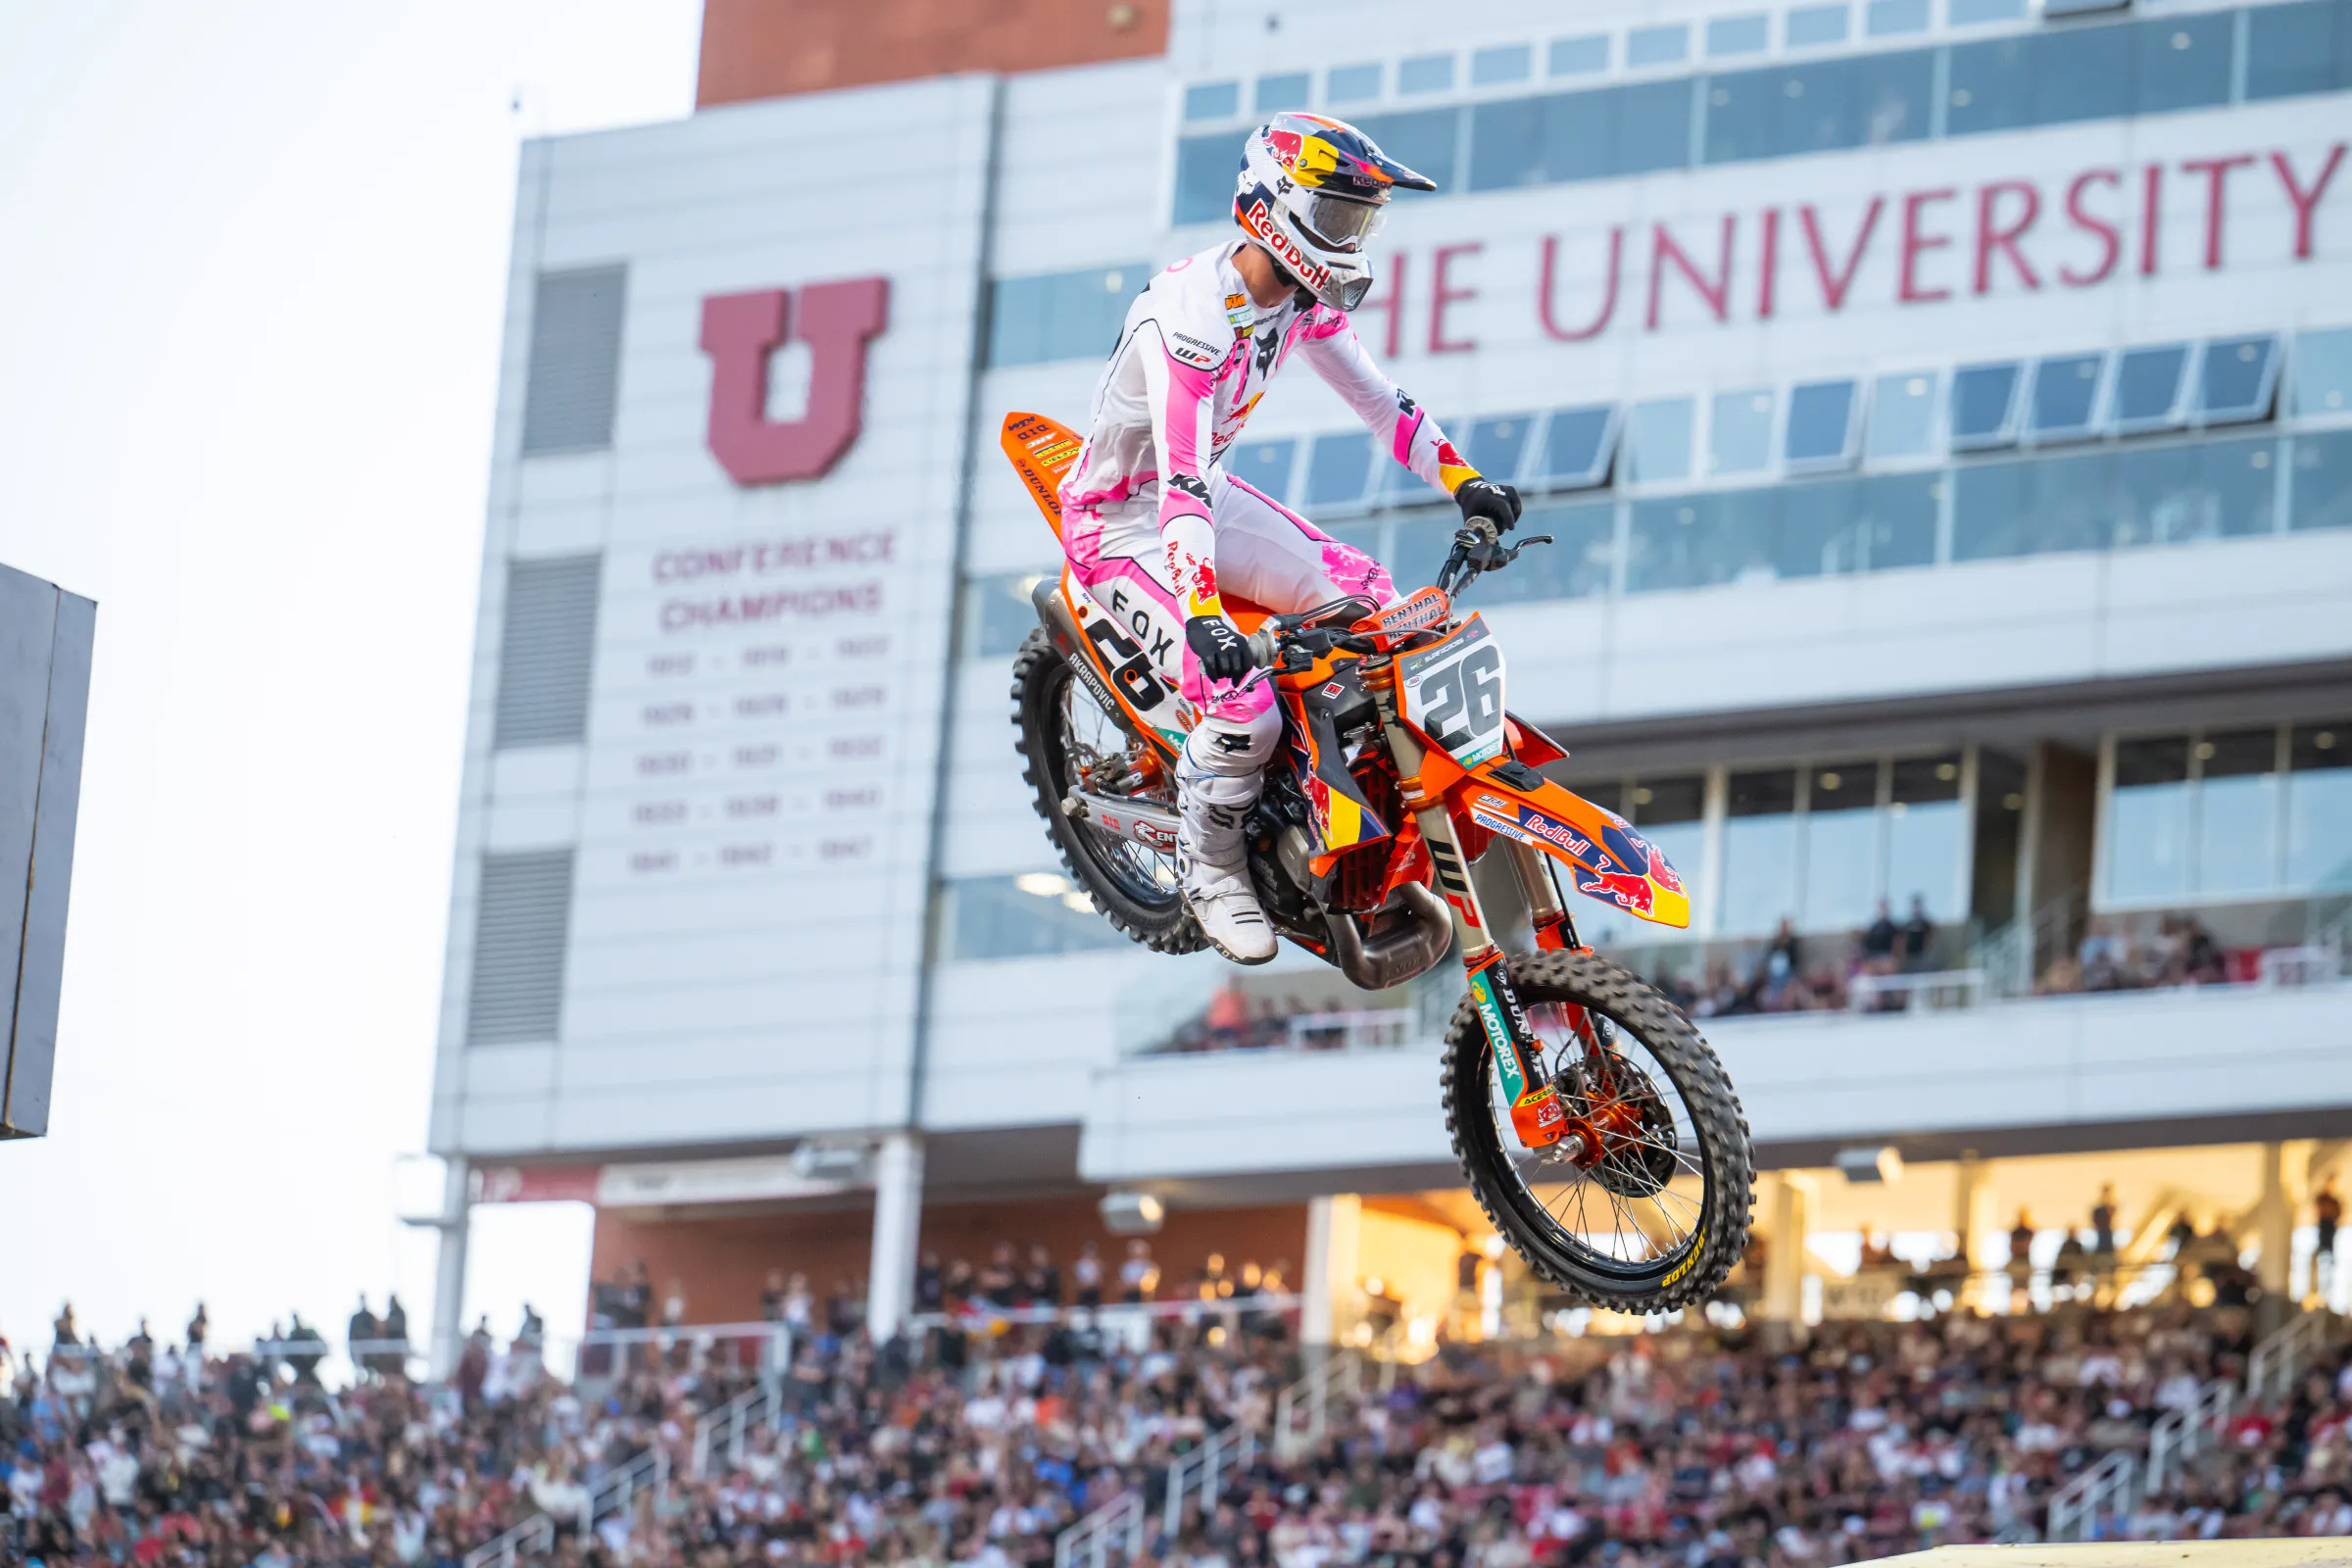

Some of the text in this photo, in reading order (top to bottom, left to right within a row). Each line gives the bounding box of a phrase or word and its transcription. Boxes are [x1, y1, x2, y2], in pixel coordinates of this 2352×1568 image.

[1356, 142, 2347, 358] HE UNIVERSITY
[1226, 294, 1248, 310] KTM
[1172, 332, 1221, 356] PROGRESSIVE
[1175, 347, 1211, 363] WP
[699, 276, 890, 487] U
[1112, 589, 1175, 666] FOX
[1202, 619, 1238, 651] FOX
[1382, 592, 1442, 626] RENTHAL
[1420, 645, 1501, 752] 26
[1475, 813, 1526, 841] PROGRESSIVE
[1427, 837, 1481, 928] WP
[1479, 1003, 1521, 1079] MOTOREX
[1662, 1231, 1705, 1288] DUNLOP
